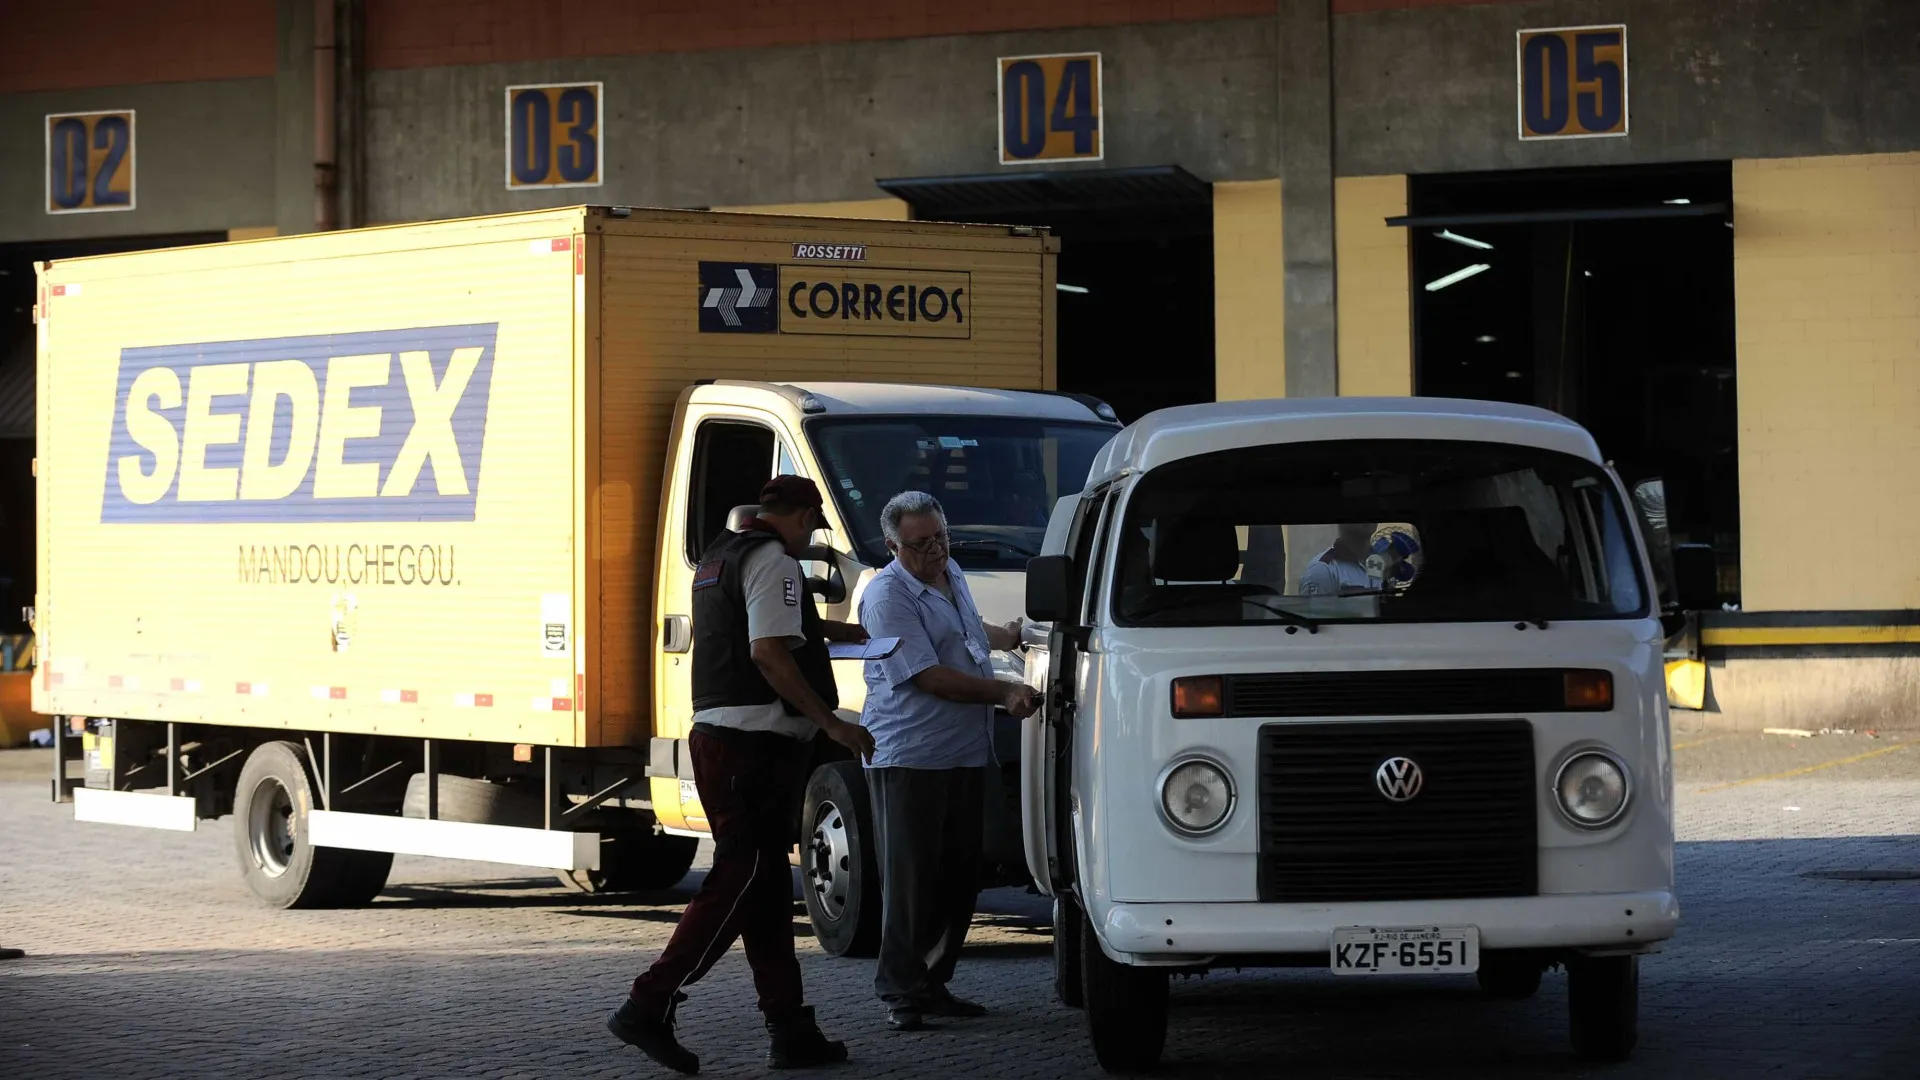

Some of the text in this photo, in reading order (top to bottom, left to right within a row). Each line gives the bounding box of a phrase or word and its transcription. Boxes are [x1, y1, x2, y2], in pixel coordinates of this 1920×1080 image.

[1003, 59, 1098, 159] 04
[1523, 32, 1621, 134] 05
[52, 115, 130, 209] 02
[512, 87, 596, 184] 03
[796, 244, 863, 260] ROSSETTI
[788, 281, 963, 323] CORREIOS
[117, 346, 485, 504] SEDEX
